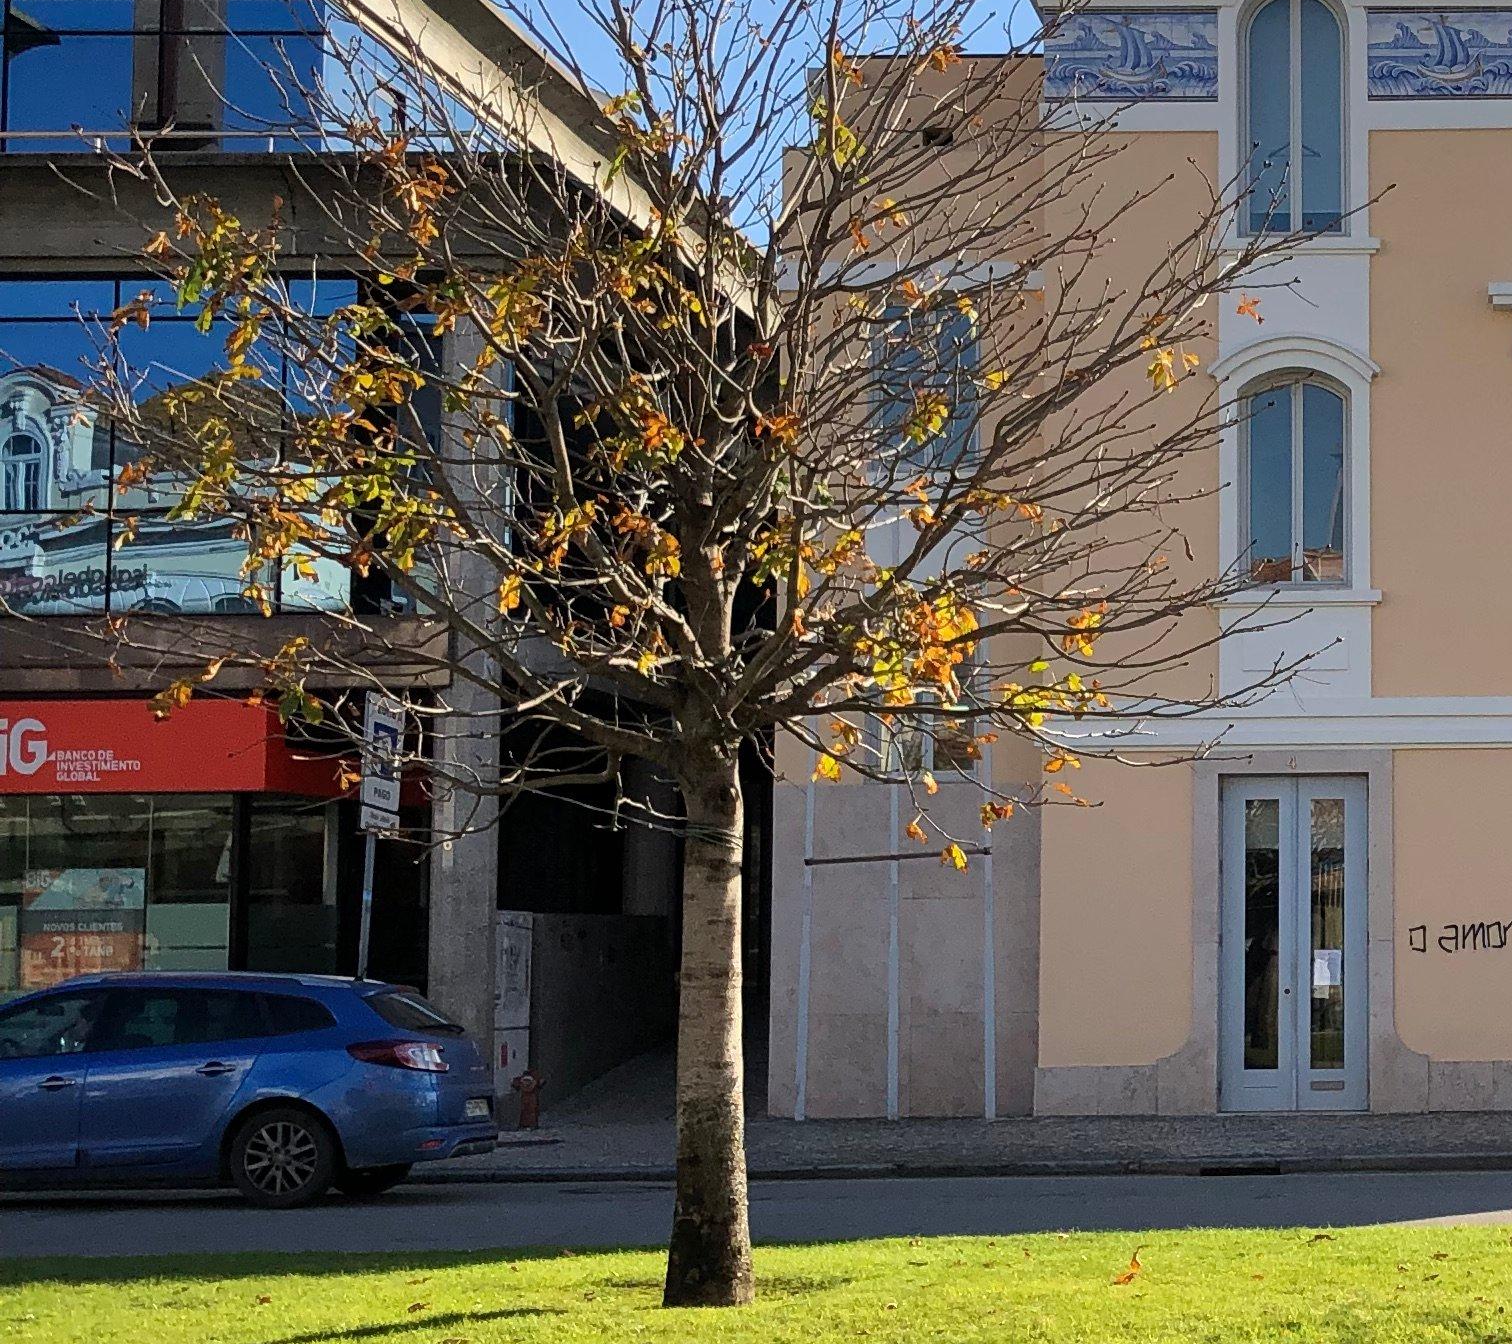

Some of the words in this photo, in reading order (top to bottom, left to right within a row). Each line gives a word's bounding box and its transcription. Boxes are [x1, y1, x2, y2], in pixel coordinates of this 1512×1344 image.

[57, 750, 96, 760] BANCO
[97, 750, 114, 760] DE
[56, 761, 140, 771] INVESTIMENTO
[56, 771, 101, 781] GLOBAL
[43, 921, 75, 932] NOVOS
[78, 921, 123, 932] CLIENTES
